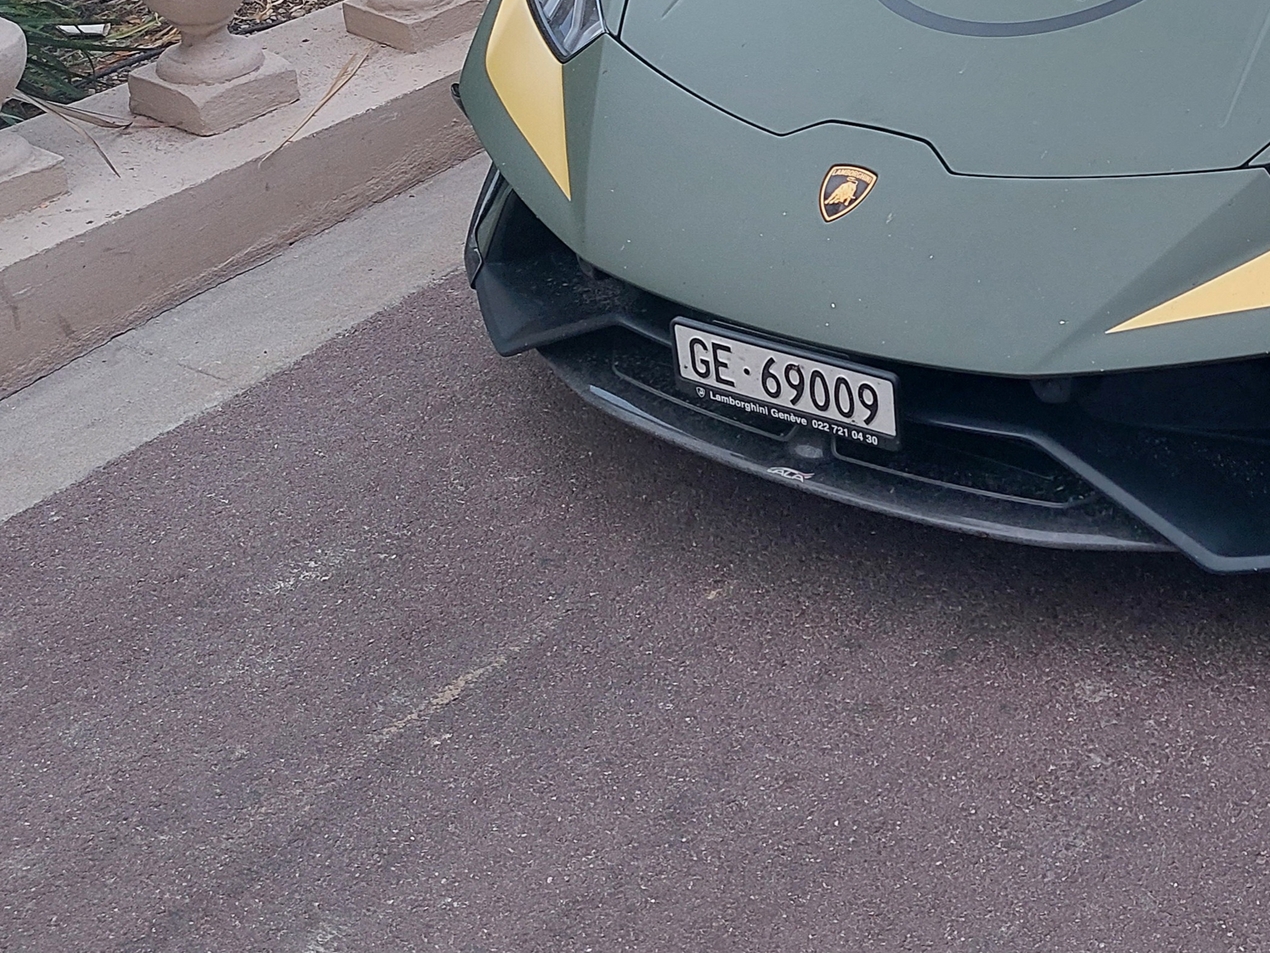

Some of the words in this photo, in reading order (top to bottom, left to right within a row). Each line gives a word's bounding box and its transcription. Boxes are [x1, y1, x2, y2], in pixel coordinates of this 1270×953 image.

[709, 390, 769, 417] Lamborghini
[770, 407, 808, 427] Genève
[811, 419, 830, 433] 022
[831, 424, 849, 438] 721
[851, 429, 864, 442] 04
[865, 433, 878, 446] 30
